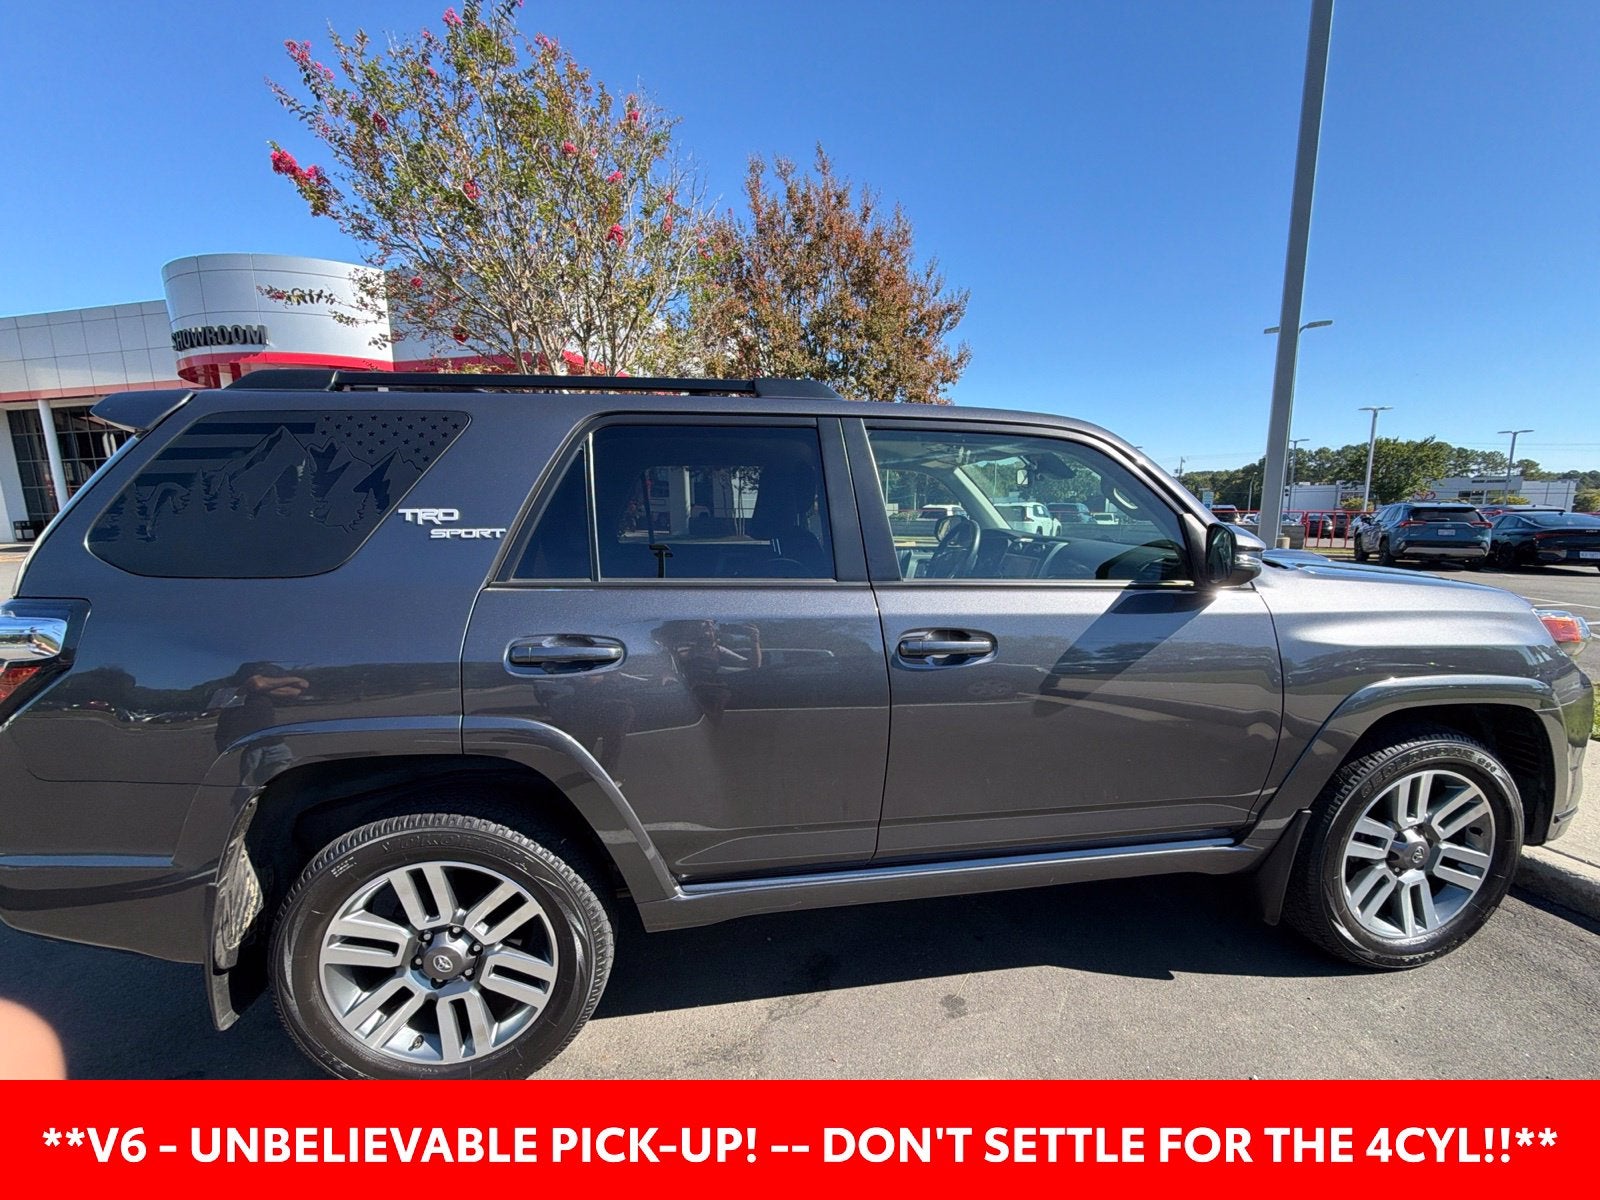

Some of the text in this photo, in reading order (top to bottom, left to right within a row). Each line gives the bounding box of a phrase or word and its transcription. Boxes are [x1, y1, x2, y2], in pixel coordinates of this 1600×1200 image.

[171, 325, 266, 351] SHOWROOM
[398, 508, 459, 525] TRD
[430, 528, 507, 539] SPORT
